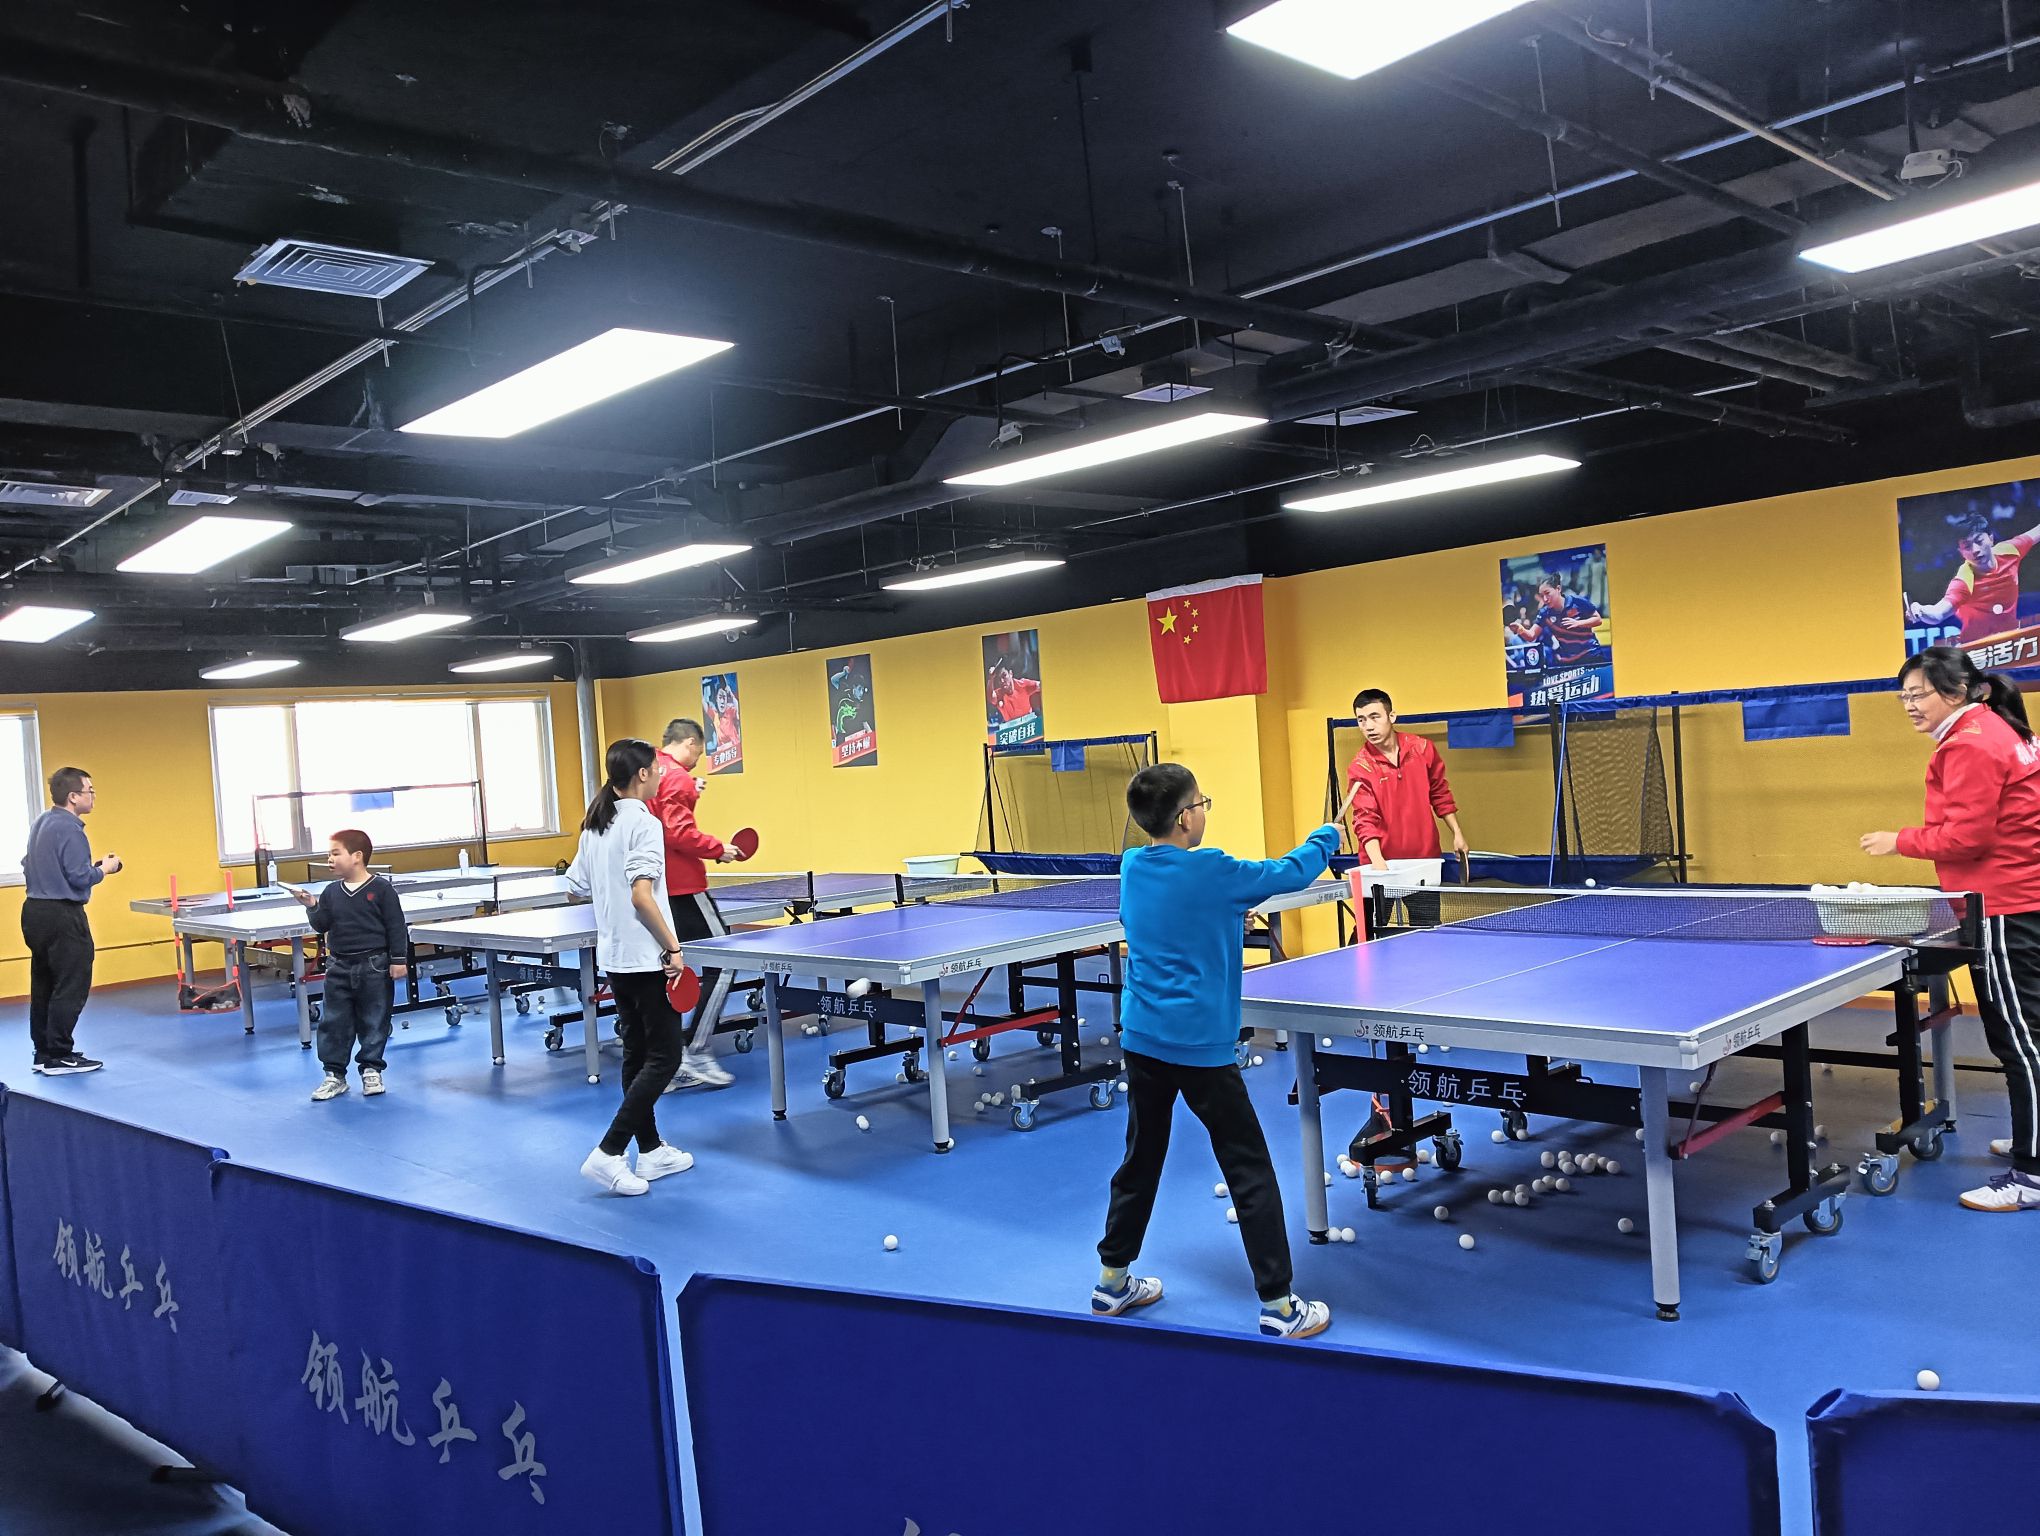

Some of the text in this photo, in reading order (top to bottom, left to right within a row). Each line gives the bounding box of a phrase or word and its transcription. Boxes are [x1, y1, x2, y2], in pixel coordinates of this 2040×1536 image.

[1543, 674, 1559, 686] LOVE
[1560, 666, 1585, 680] SPORTS
[1530, 674, 1600, 706] 热爱运动
[1000, 722, 1036, 745] 突破自我
[951, 957, 982, 974] 领航乒乓
[820, 995, 875, 1018] 领航乒乓
[1373, 1023, 1425, 1042] 领航乒乓
[1733, 1023, 1761, 1048] 领航乒乓
[1408, 1069, 1524, 1108] 领航乒乓
[53, 1217, 179, 1333] 领航乒乓
[301, 1329, 547, 1505] 领航乒乓
